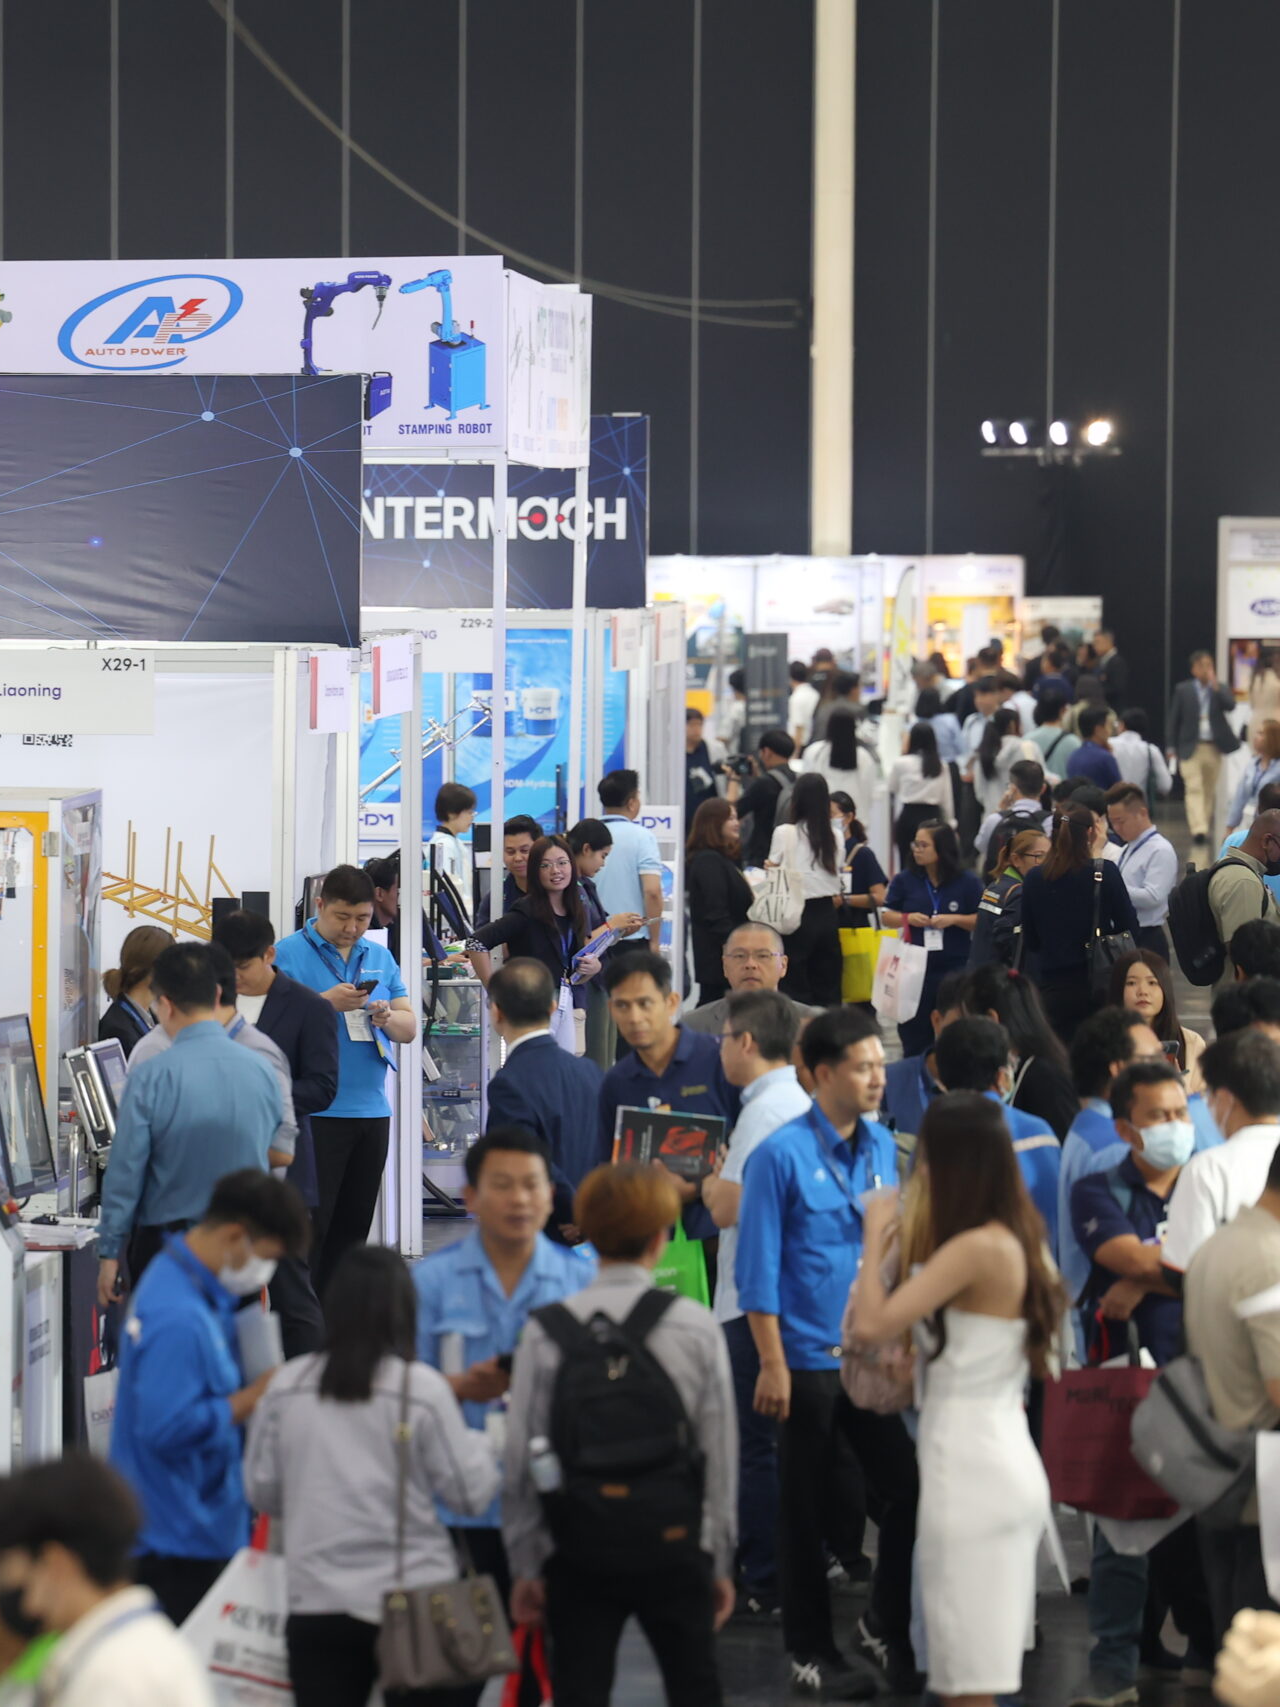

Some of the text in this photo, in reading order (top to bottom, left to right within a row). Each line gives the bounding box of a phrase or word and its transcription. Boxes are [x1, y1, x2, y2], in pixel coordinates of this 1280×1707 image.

[84, 347, 187, 356] AUTO POWER
[398, 422, 493, 435] STAMPING ROBOT
[101, 657, 146, 672] X29-1
